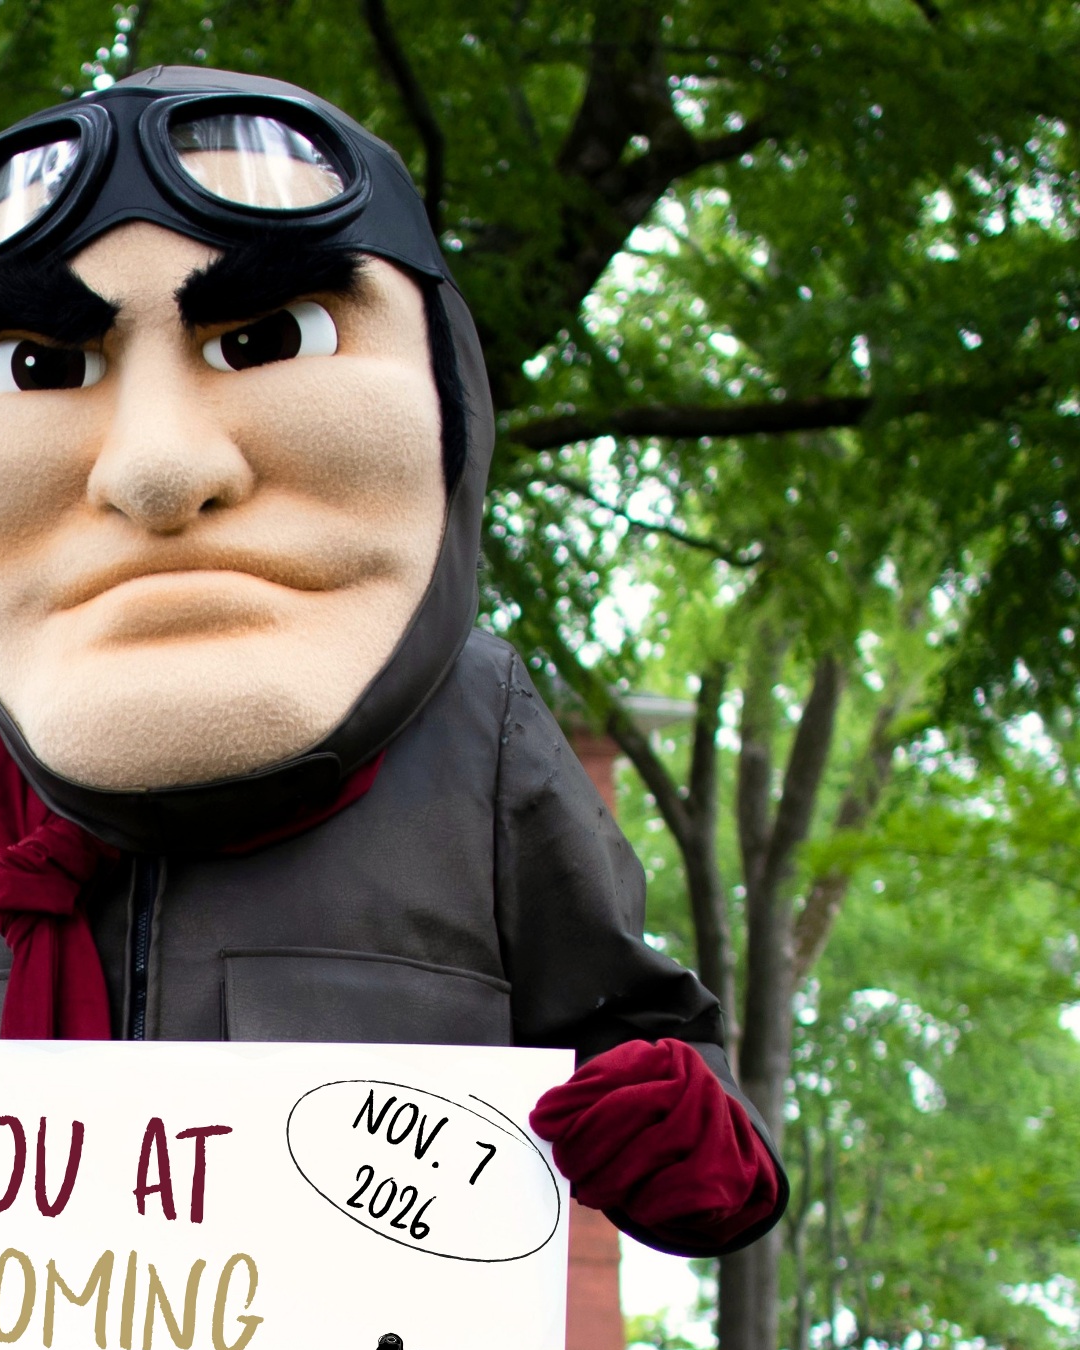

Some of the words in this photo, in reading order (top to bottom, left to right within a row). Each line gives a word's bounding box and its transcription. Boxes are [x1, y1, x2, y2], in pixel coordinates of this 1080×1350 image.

[133, 1117, 232, 1224] AT
[352, 1089, 448, 1168] NOV.
[469, 1141, 496, 1185] 7
[347, 1165, 436, 1239] 2026
